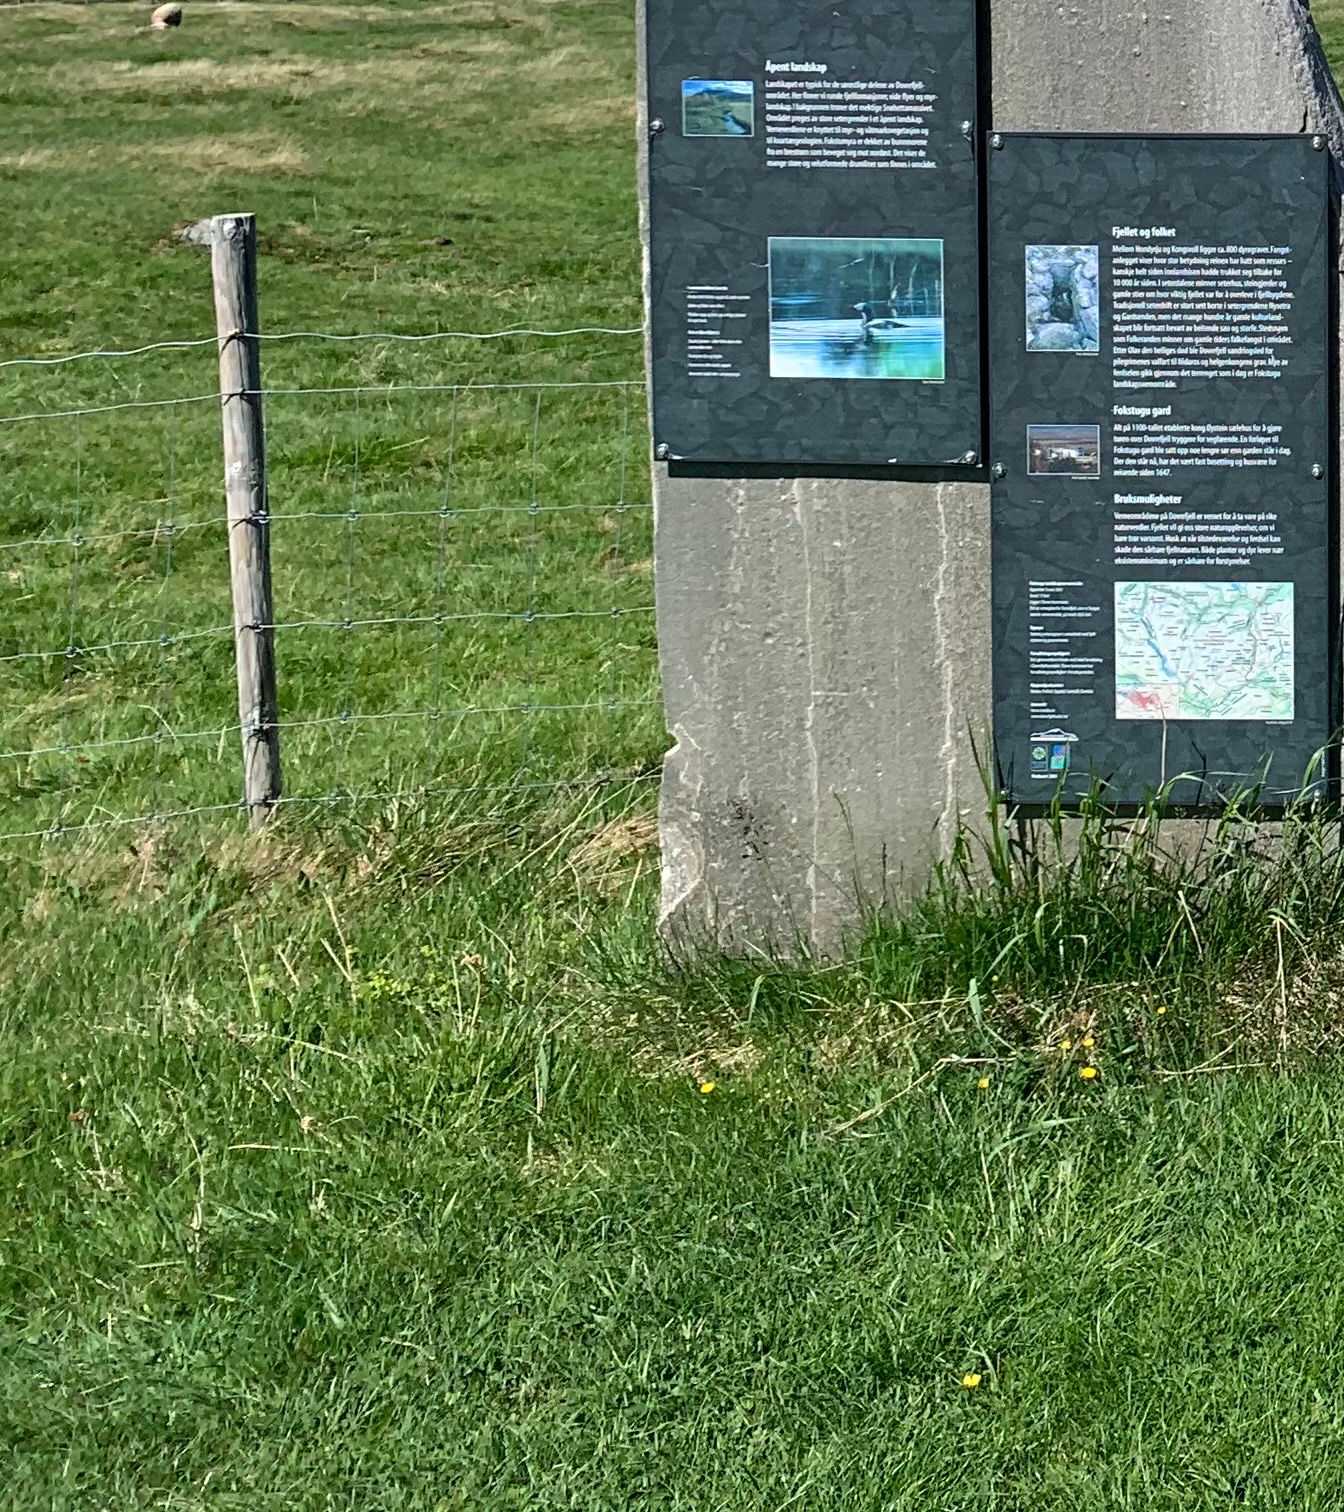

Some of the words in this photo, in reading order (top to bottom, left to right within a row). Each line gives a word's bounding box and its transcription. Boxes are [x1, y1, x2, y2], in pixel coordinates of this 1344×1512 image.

[765, 60, 789, 74] Åpent
[791, 61, 827, 74] landskap
[1112, 227, 1138, 238] Fjellet
[1140, 229, 1150, 238] og
[1152, 227, 1176, 236] folket
[1114, 405, 1150, 417] Fokstugu
[1152, 405, 1171, 418] gard
[1114, 494, 1182, 506] Bruksmuligheter
